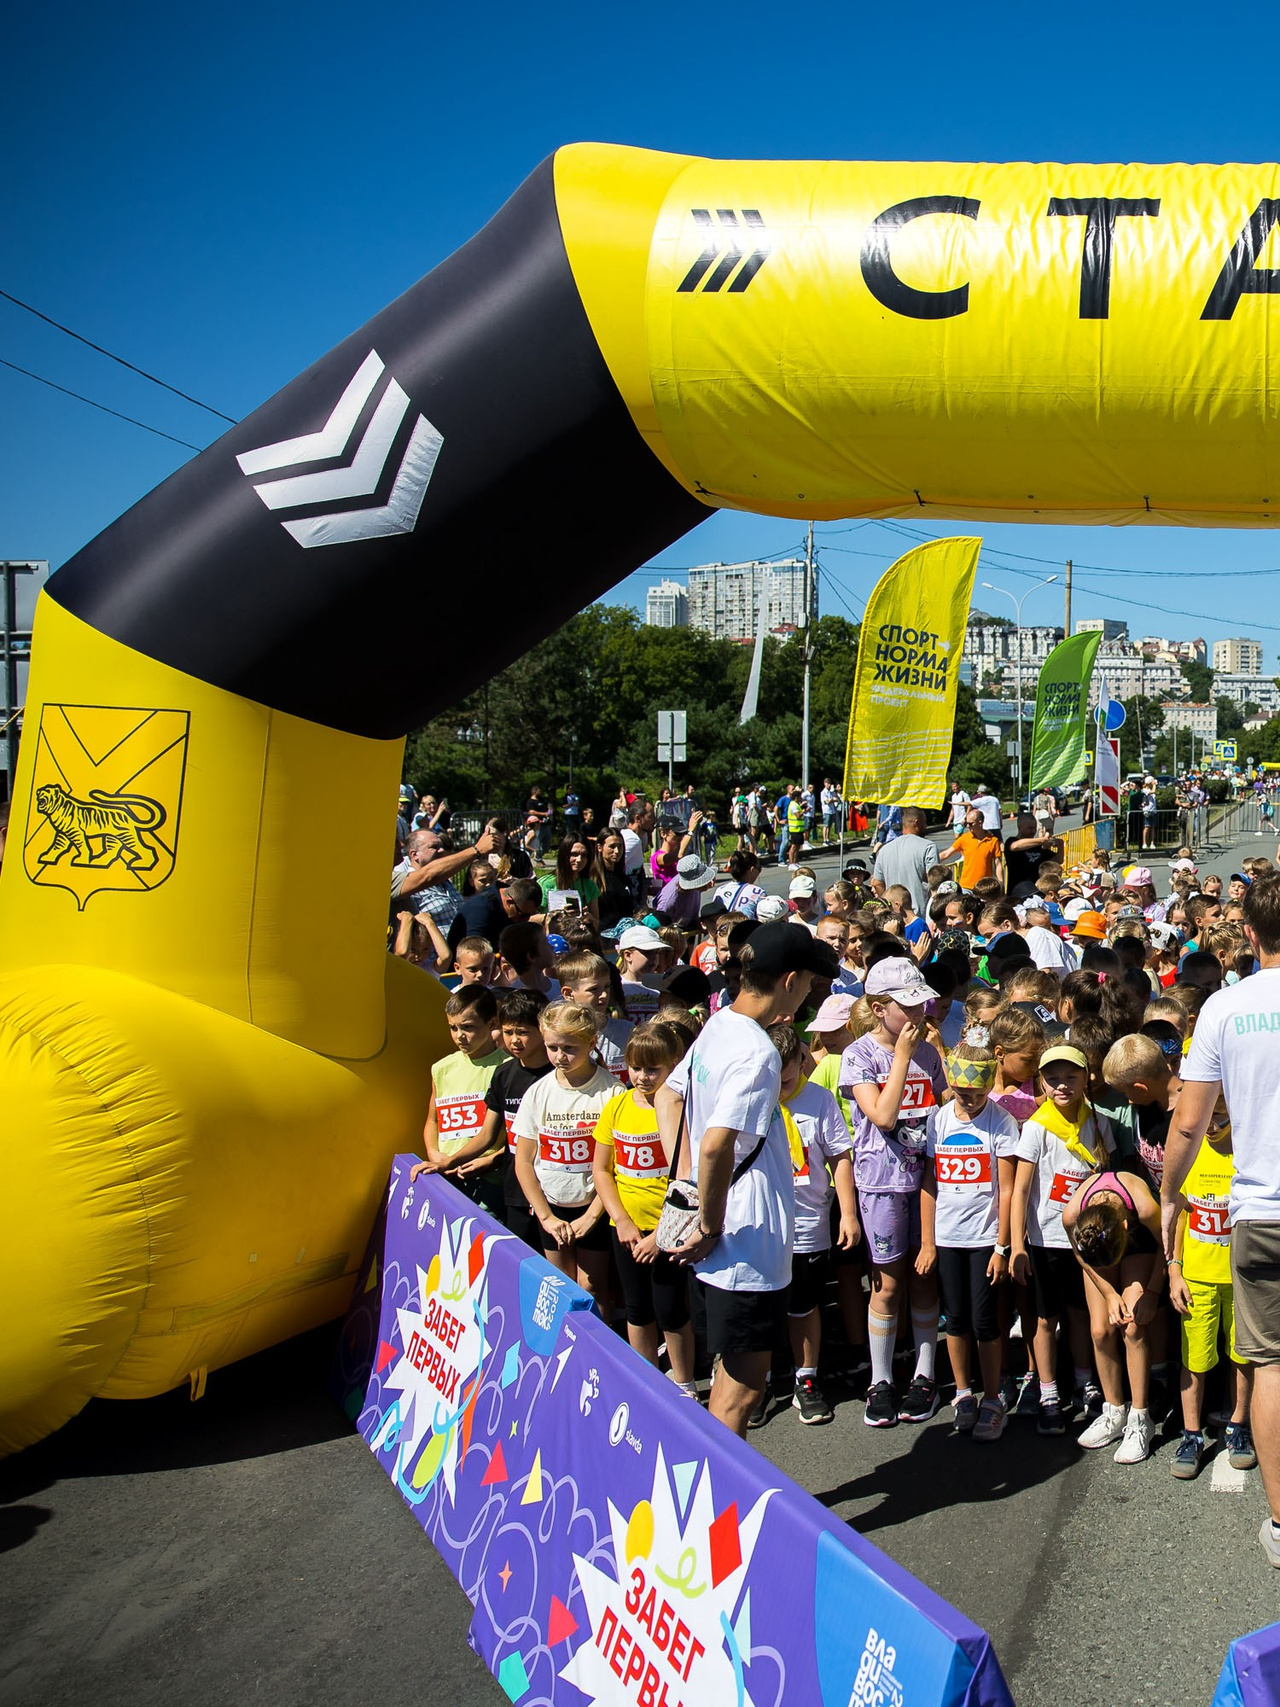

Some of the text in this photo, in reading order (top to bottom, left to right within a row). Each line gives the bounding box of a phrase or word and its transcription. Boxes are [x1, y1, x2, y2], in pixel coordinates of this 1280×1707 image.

[878, 624, 939, 649] СПОРТ
[875, 644, 949, 673] НОРМА
[873, 664, 947, 692] ЖИЗНИ
[1044, 682, 1079, 694] СПОРТ
[1044, 704, 1080, 717] ЖИЗНИ
[451, 1094, 480, 1102] ПЕРВЫХ
[902, 1083, 925, 1106] 27
[440, 1104, 478, 1130] 353
[546, 1110, 601, 1122] Amsterdam
[543, 1128, 594, 1137] ЗАБЕГ ПЕРВЫХ
[615, 1132, 661, 1142] ЗАБЕГ ПЕРВЫ
[548, 1139, 590, 1162] 318
[622, 1145, 656, 1168] 78
[938, 1157, 982, 1181] 329
[1062, 1168, 1084, 1176] ЗАБЕГ
[1193, 1197, 1212, 1208] ЗАБЕГ
[424, 1298, 466, 1354] ЗАБЕГ
[406, 1330, 461, 1405] ПЕРВЫХ
[624, 1429, 643, 1455] slavda
[625, 1567, 706, 1684] ЗАБЕГ
[595, 1605, 684, 1707] ПЕРВ
